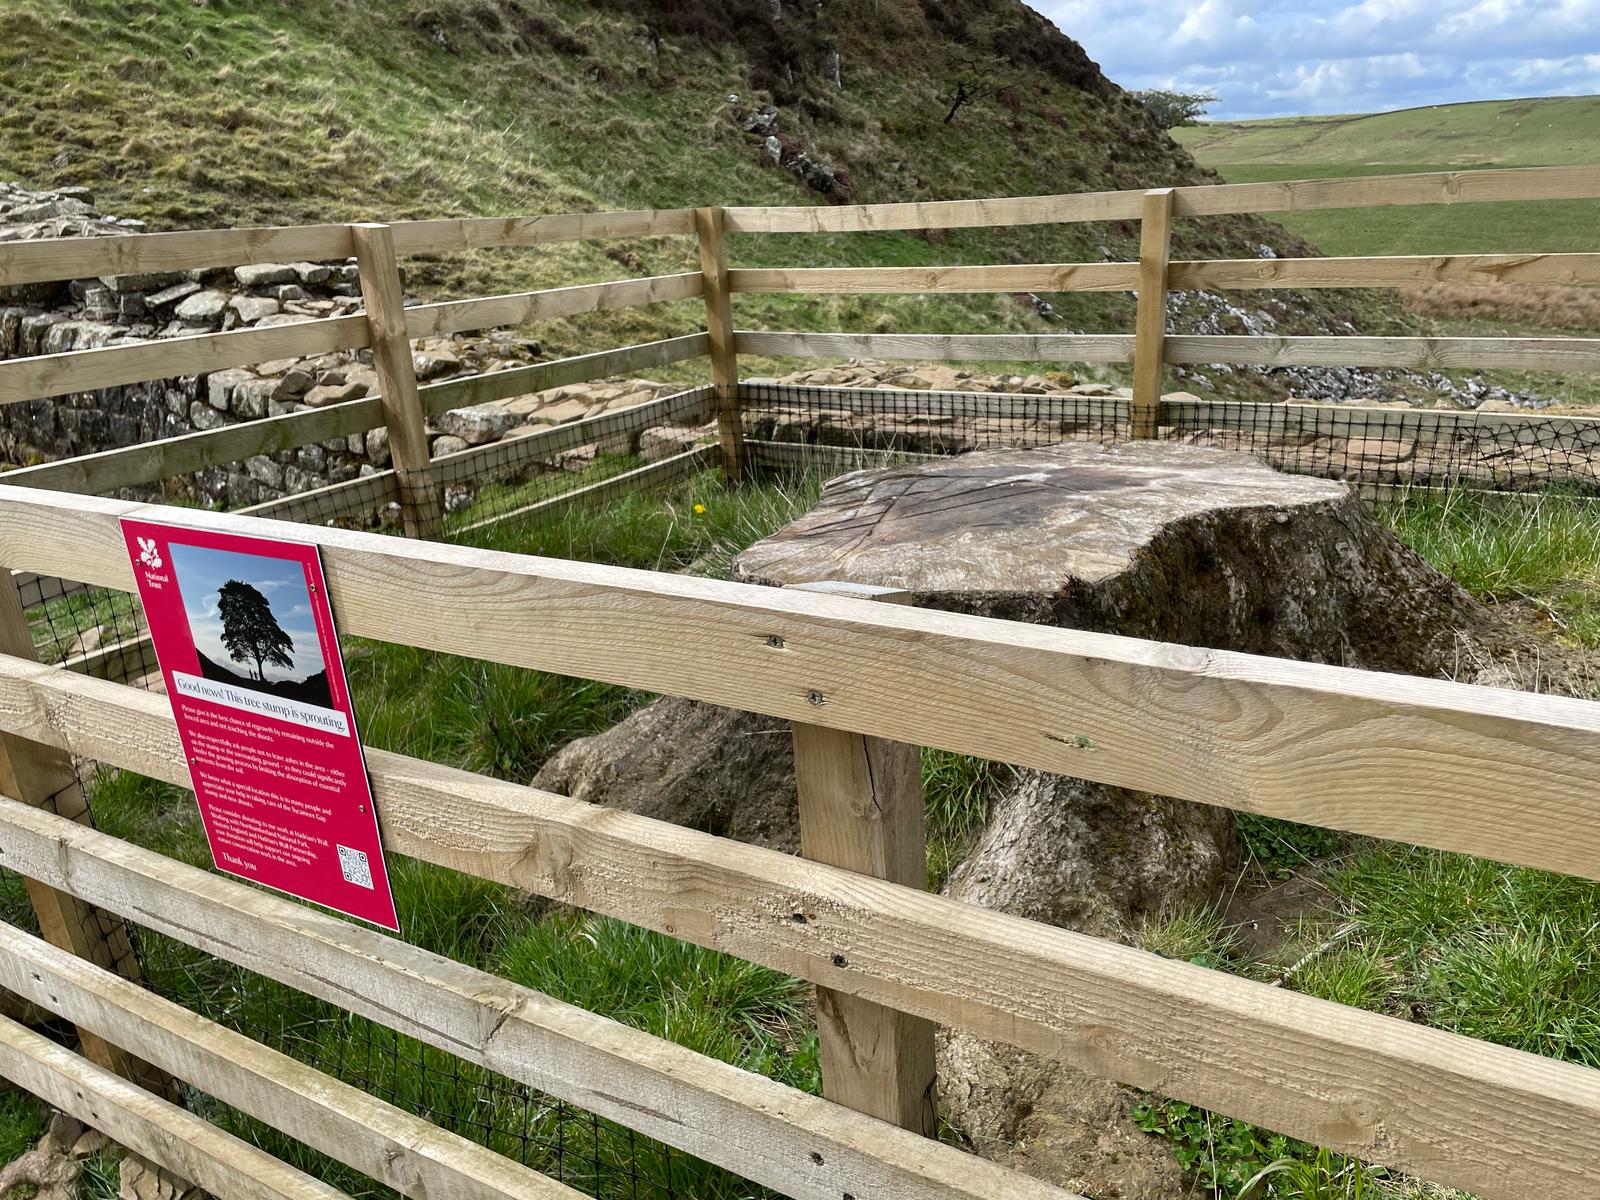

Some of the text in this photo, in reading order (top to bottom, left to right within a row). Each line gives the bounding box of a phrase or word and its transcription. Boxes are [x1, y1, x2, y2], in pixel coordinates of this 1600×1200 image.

[144, 571, 169, 582] National
[146, 579, 162, 589] Trust
[177, 678, 201, 693] Good
[201, 687, 224, 699] news!
[224, 689, 243, 703] This
[243, 696, 260, 709] tree
[262, 702, 290, 719] stump
[290, 706, 298, 718] is
[181, 704, 196, 713] Please
[218, 714, 229, 722] best
[228, 717, 245, 726] chance
[251, 724, 274, 734] regrowth
[281, 731, 306, 743] remaining
[305, 737, 325, 746] outside
[184, 713, 200, 722] fenced
[227, 725, 248, 736] touching
[195, 756, 216, 766] nutrients
[215, 760, 227, 769] from
[197, 732, 206, 740] also
[206, 736, 232, 748] respectfully
[240, 745, 256, 753] people
[271, 752, 284, 761] leave
[285, 757, 298, 765] ashes
[304, 761, 313, 769] the
[330, 769, 345, 777] either
[205, 743, 220, 753] stump
[234, 751, 262, 764] surrounding
[262, 759, 280, 768] ground
[290, 766, 302, 775] they
[302, 770, 316, 778] could
[317, 774, 346, 787] significantly
[216, 754, 234, 764] growing
[234, 759, 252, 768] process
[286, 773, 313, 785] absorption
[318, 783, 340, 793] essential
[202, 781, 224, 791] appreciate
[235, 789, 246, 799] help
[251, 795, 266, 805] taking
[281, 803, 291, 811] the
[291, 806, 315, 818] Sycamore
[315, 813, 326, 822] Gap
[204, 789, 218, 799] stump
[207, 774, 220, 782] know
[220, 778, 231, 786] what
[235, 783, 251, 792] special
[250, 786, 270, 797] location
[270, 792, 279, 800] this
[290, 799, 304, 808] many
[304, 803, 321, 812] people
[208, 803, 222, 813] Please
[222, 809, 241, 819] consider
[242, 814, 262, 827] donating
[276, 826, 289, 834] work
[210, 811, 230, 824] Working
[239, 820, 277, 838] Northumberland
[276, 832, 297, 844] National
[212, 820, 229, 830] Historic
[230, 825, 248, 836] England
[278, 841, 289, 849] Wall
[217, 837, 231, 845] nature
[231, 841, 260, 854] conservation
[222, 852, 257, 871] Thank you
[225, 831, 246, 842] donation
[253, 840, 264, 849] help
[264, 845, 282, 854] support
[291, 854, 311, 864] ongoing
